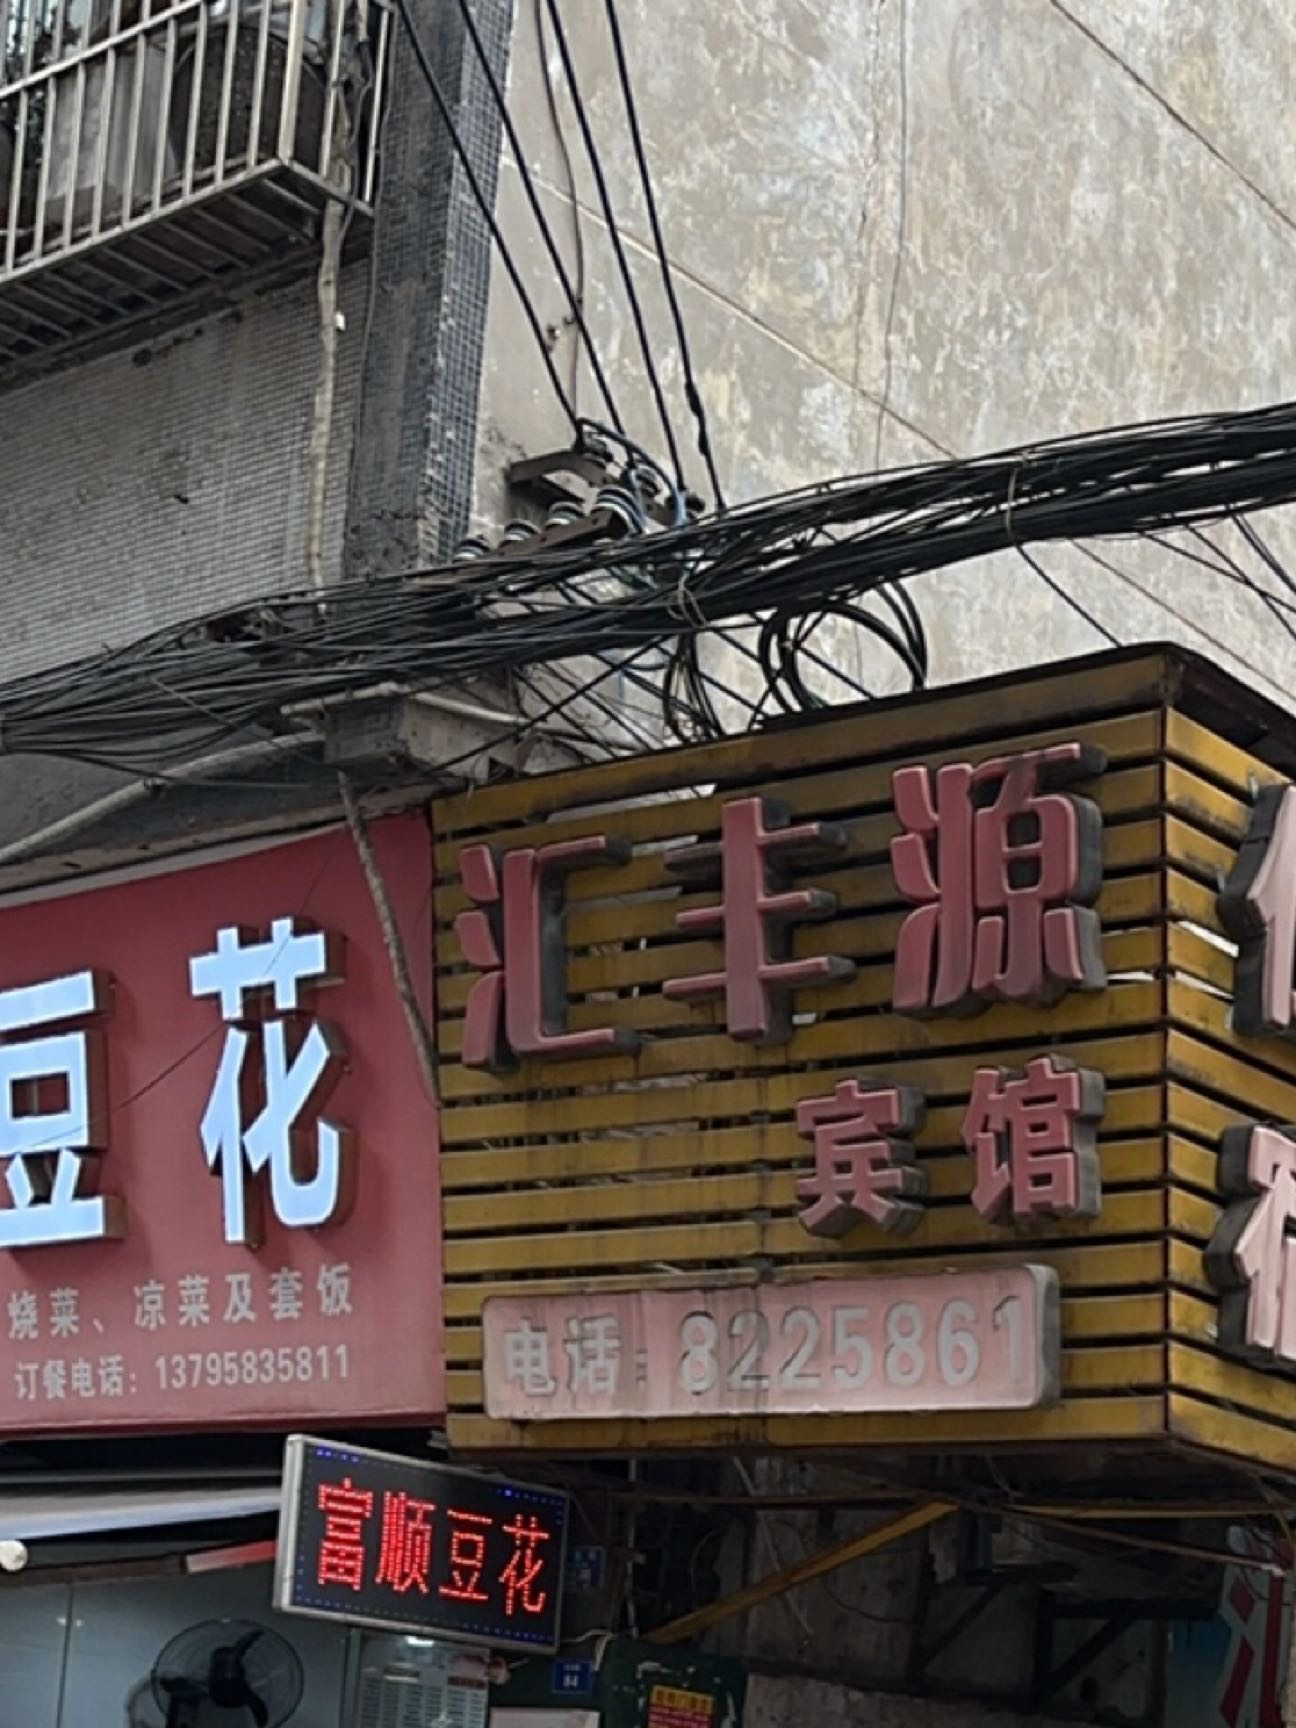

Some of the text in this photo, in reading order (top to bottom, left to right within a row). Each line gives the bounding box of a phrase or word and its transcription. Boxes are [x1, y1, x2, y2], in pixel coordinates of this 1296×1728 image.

[456, 742, 1092, 1068] 汇丰源
[0, 917, 342, 1247] 豆花
[797, 1055, 1095, 1234] 宾馆
[156, 1344, 349, 1390] 13795835811
[679, 1294, 1022, 1392] 8225861
[316, 1477, 551, 1616] 富顺豆花
